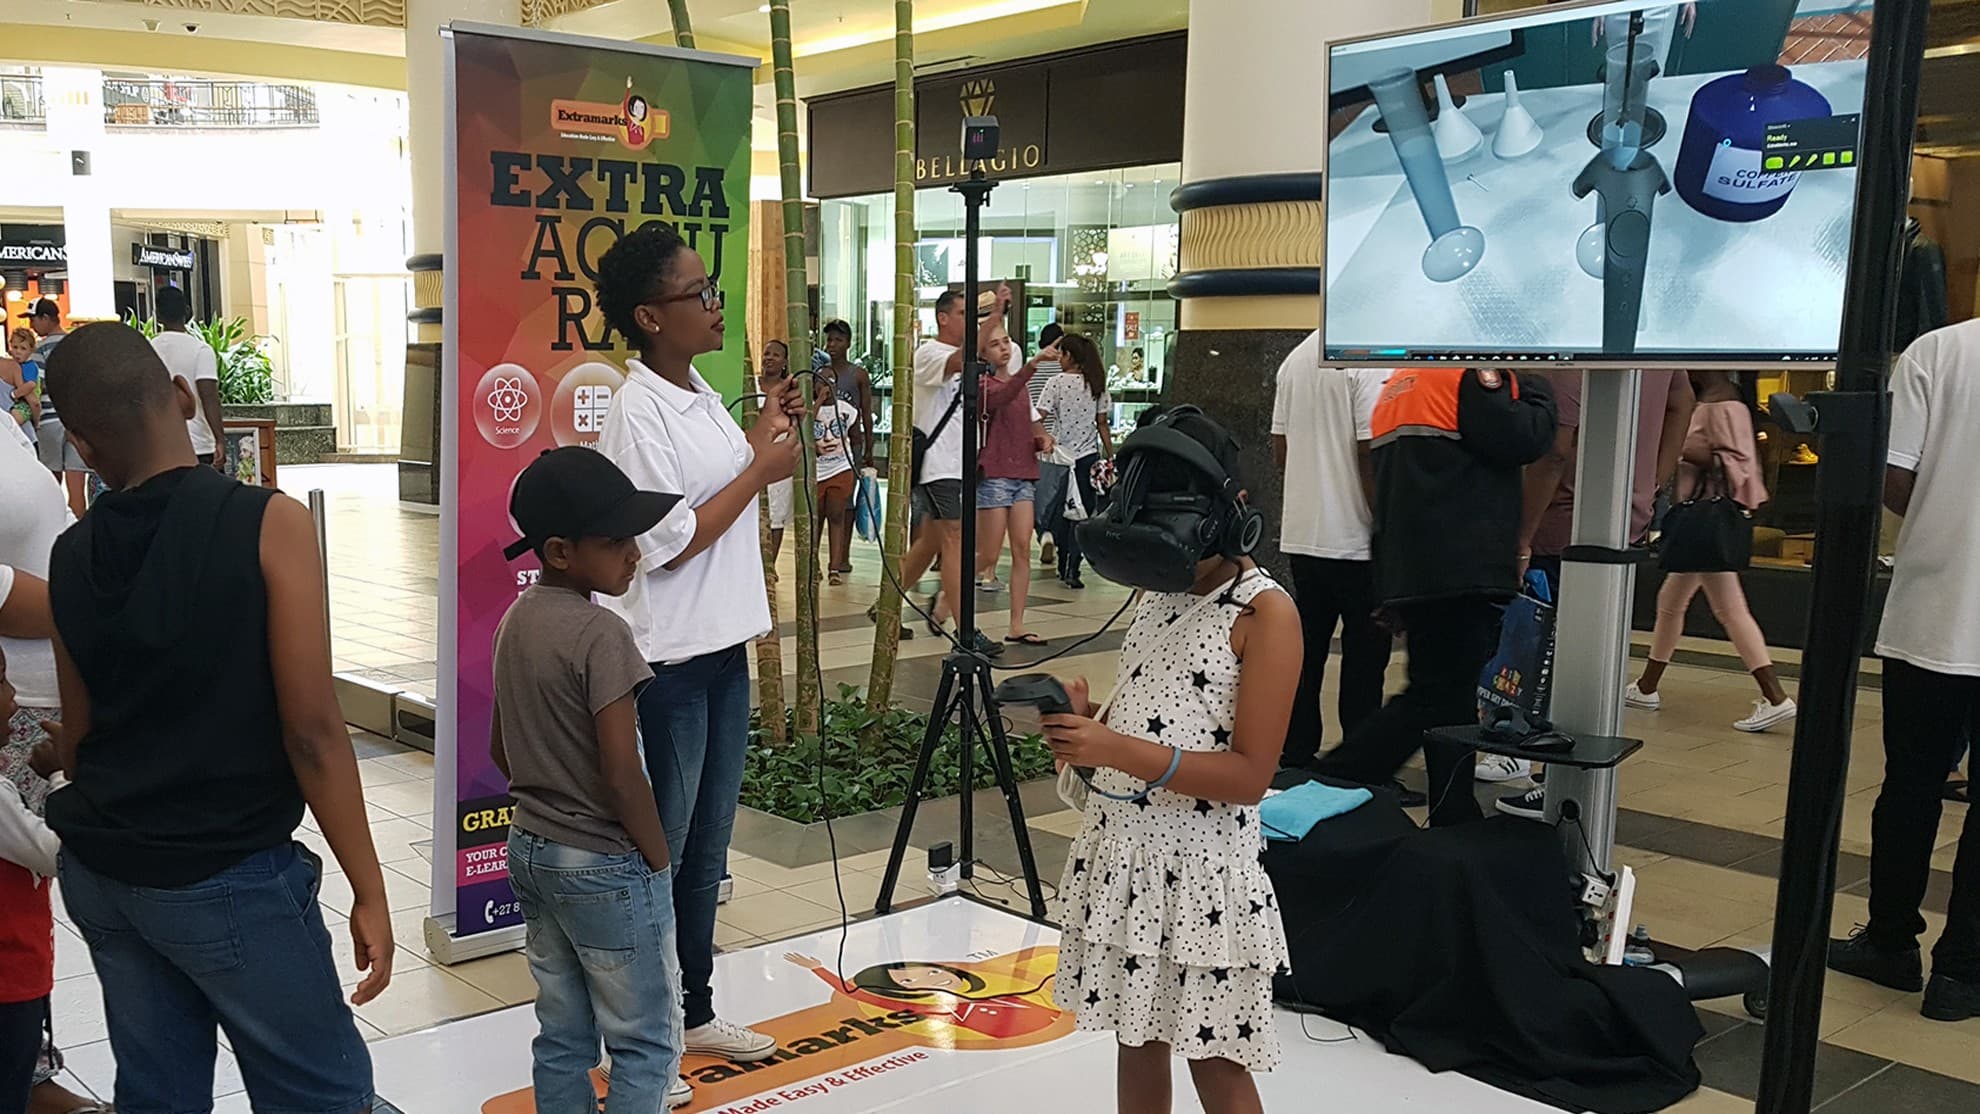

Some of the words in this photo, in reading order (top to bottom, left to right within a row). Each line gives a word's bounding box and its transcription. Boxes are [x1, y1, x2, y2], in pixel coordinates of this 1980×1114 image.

[558, 109, 628, 127] Extramarks
[916, 144, 1040, 180] BELLAGIO
[490, 151, 730, 218] EXTRA
[1717, 174, 1796, 189] SULFATE
[521, 214, 729, 288] ACU
[495, 426, 521, 435] Science
[516, 569, 540, 586] ST
[465, 849, 498, 863] YOUR
[499, 846, 508, 860] C
[465, 859, 508, 877] E-LEAR
[493, 903, 511, 916] +27
[513, 902, 521, 913] 8
[718, 1096, 779, 1114] Made
[782, 1081, 829, 1101] Easy
[829, 1076, 847, 1088] &
[843, 1050, 929, 1083] Effective
